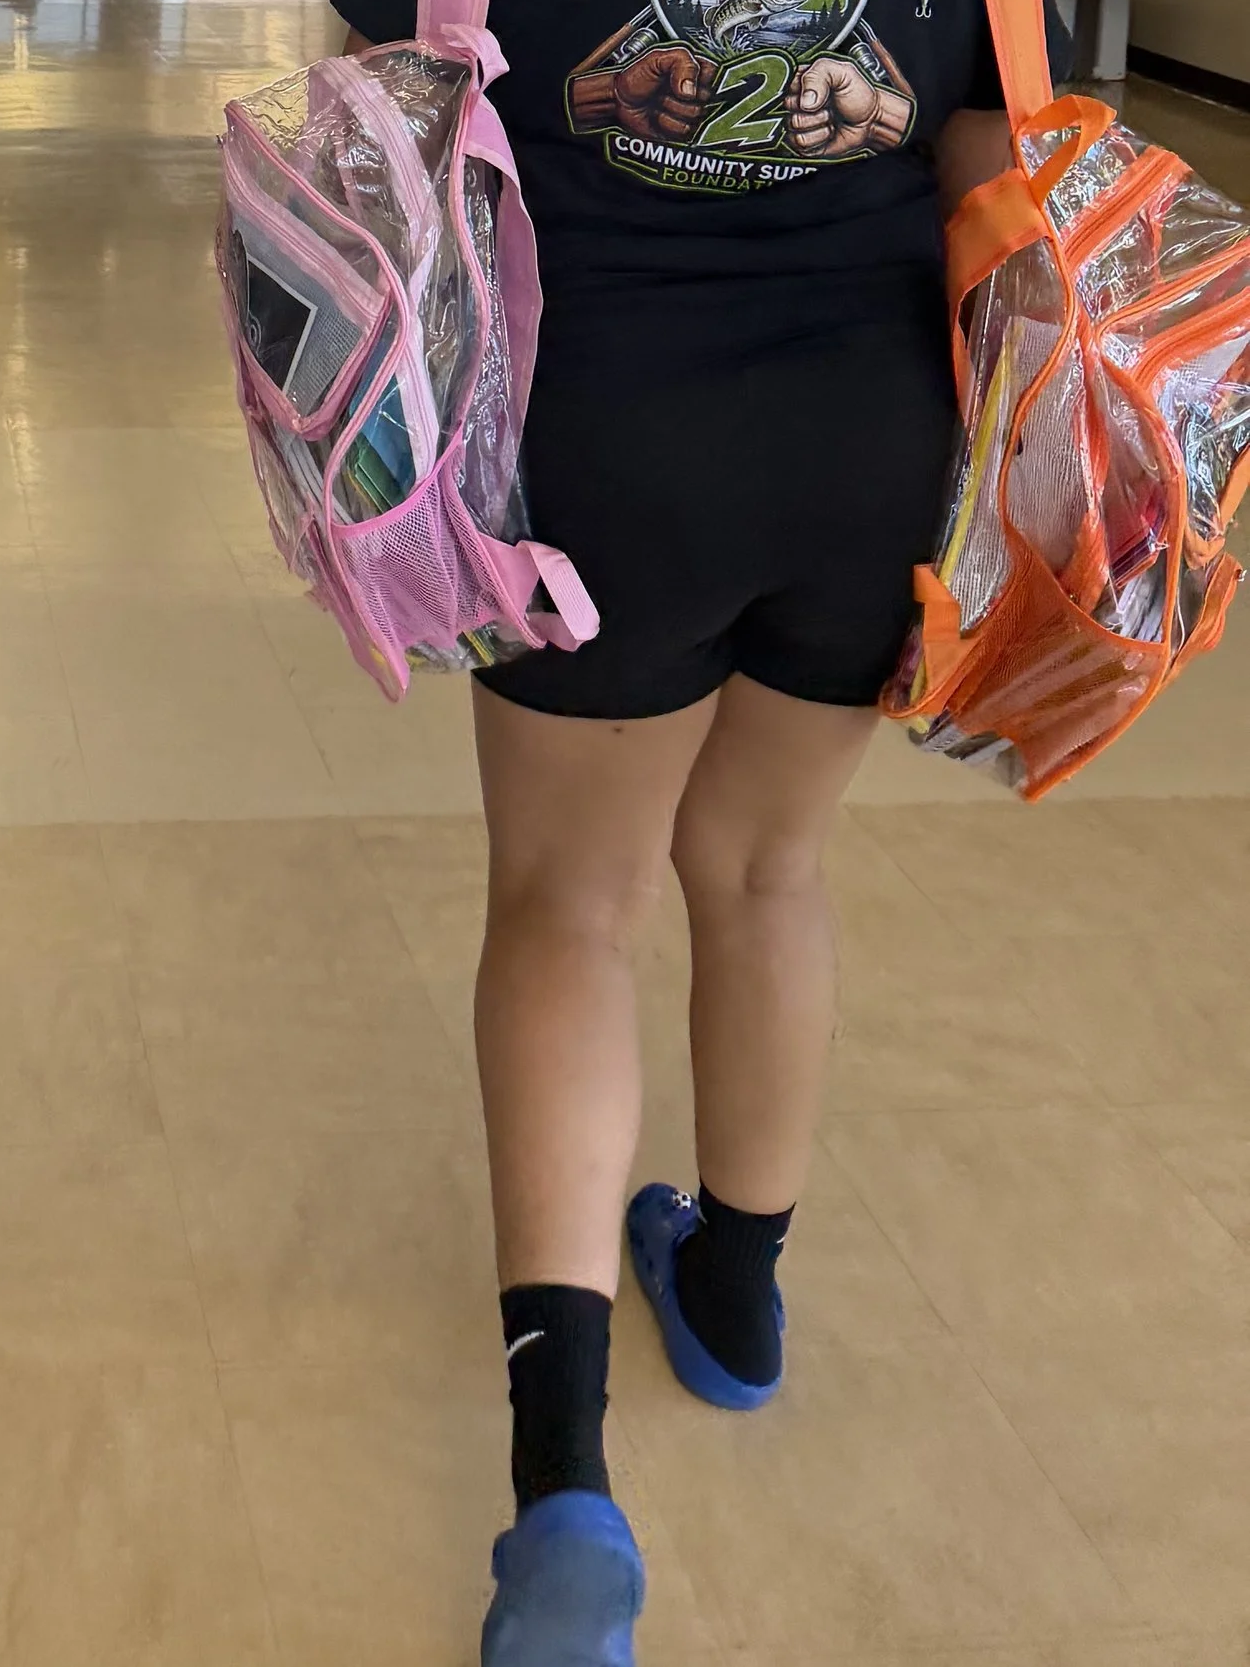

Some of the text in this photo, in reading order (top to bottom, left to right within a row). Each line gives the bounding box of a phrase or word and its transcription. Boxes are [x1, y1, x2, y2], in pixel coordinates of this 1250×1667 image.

[692, 51, 791, 149] 2
[614, 135, 755, 178] COMMUNITY
[662, 166, 774, 191] FOUNDAT
